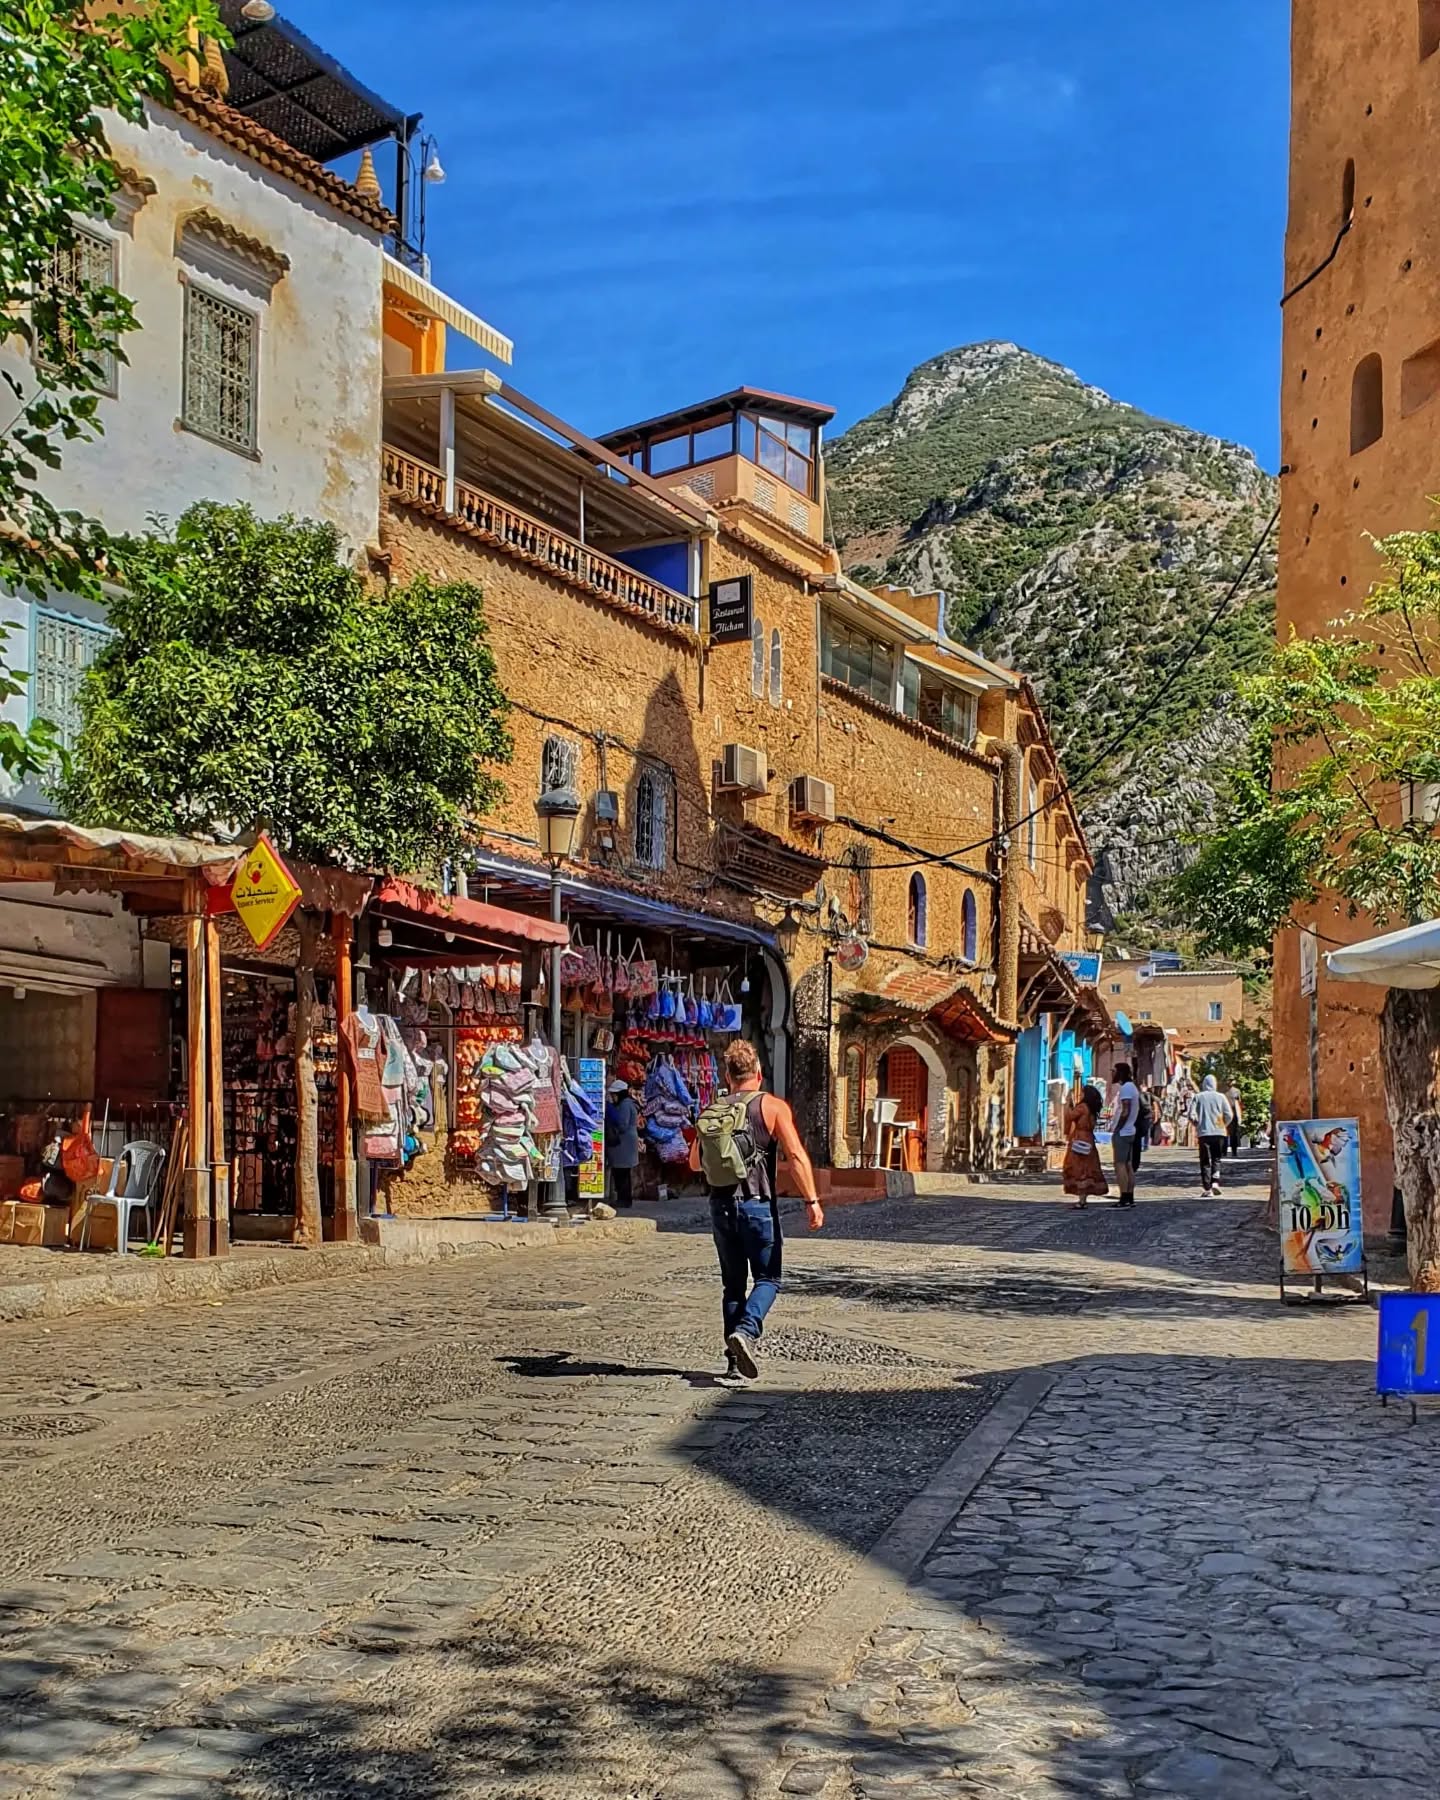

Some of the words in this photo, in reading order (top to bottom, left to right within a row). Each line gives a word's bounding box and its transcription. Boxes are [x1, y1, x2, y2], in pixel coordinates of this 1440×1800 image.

[713, 606, 745, 619] Restaurant
[715, 621, 744, 634] Hicham
[255, 897, 275, 905] Service
[1290, 1206, 1311, 1232] 10
[1319, 1203, 1350, 1230] Dh
[1410, 1309, 1428, 1376] 1
